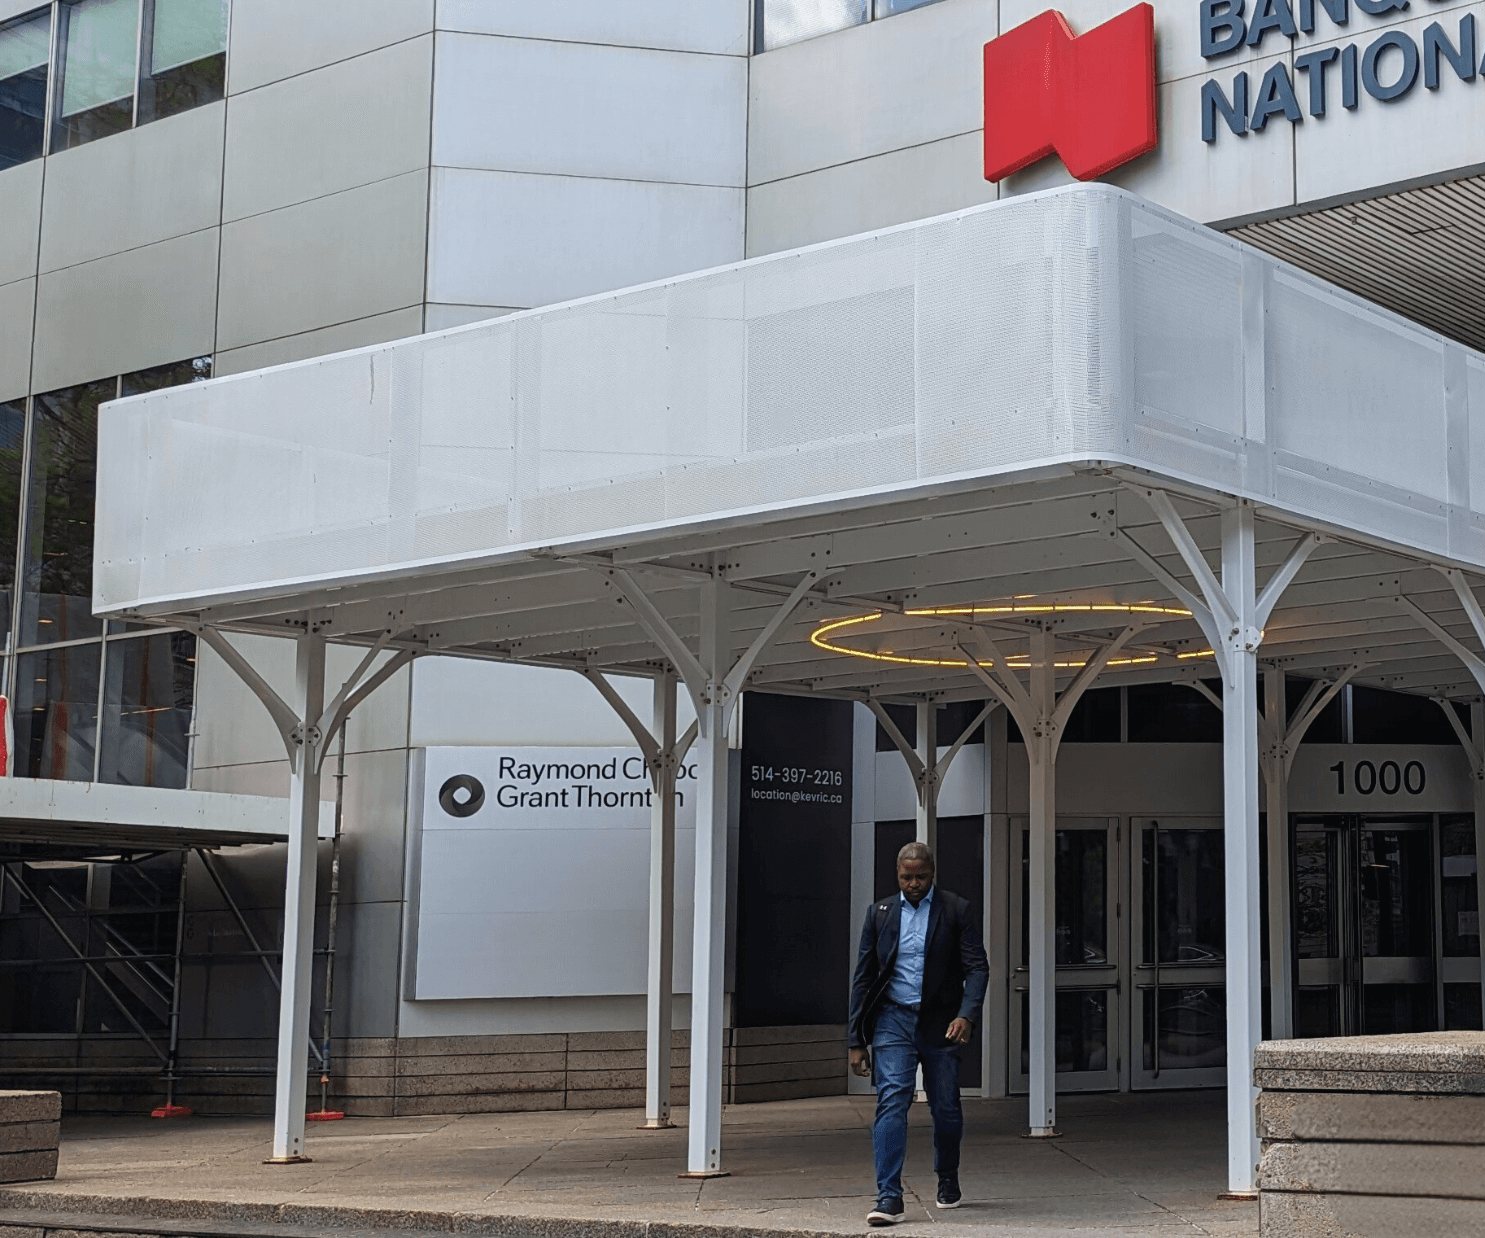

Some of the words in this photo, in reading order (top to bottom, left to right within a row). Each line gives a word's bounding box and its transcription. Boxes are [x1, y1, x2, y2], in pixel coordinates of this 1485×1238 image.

[498, 756, 617, 786] Raymond
[751, 765, 843, 786] 514-397-2216
[1329, 760, 1427, 795] 1000
[496, 783, 570, 808] Grant
[571, 784, 685, 808] Thorntn
[751, 787, 843, 805] location@kevric.ca
